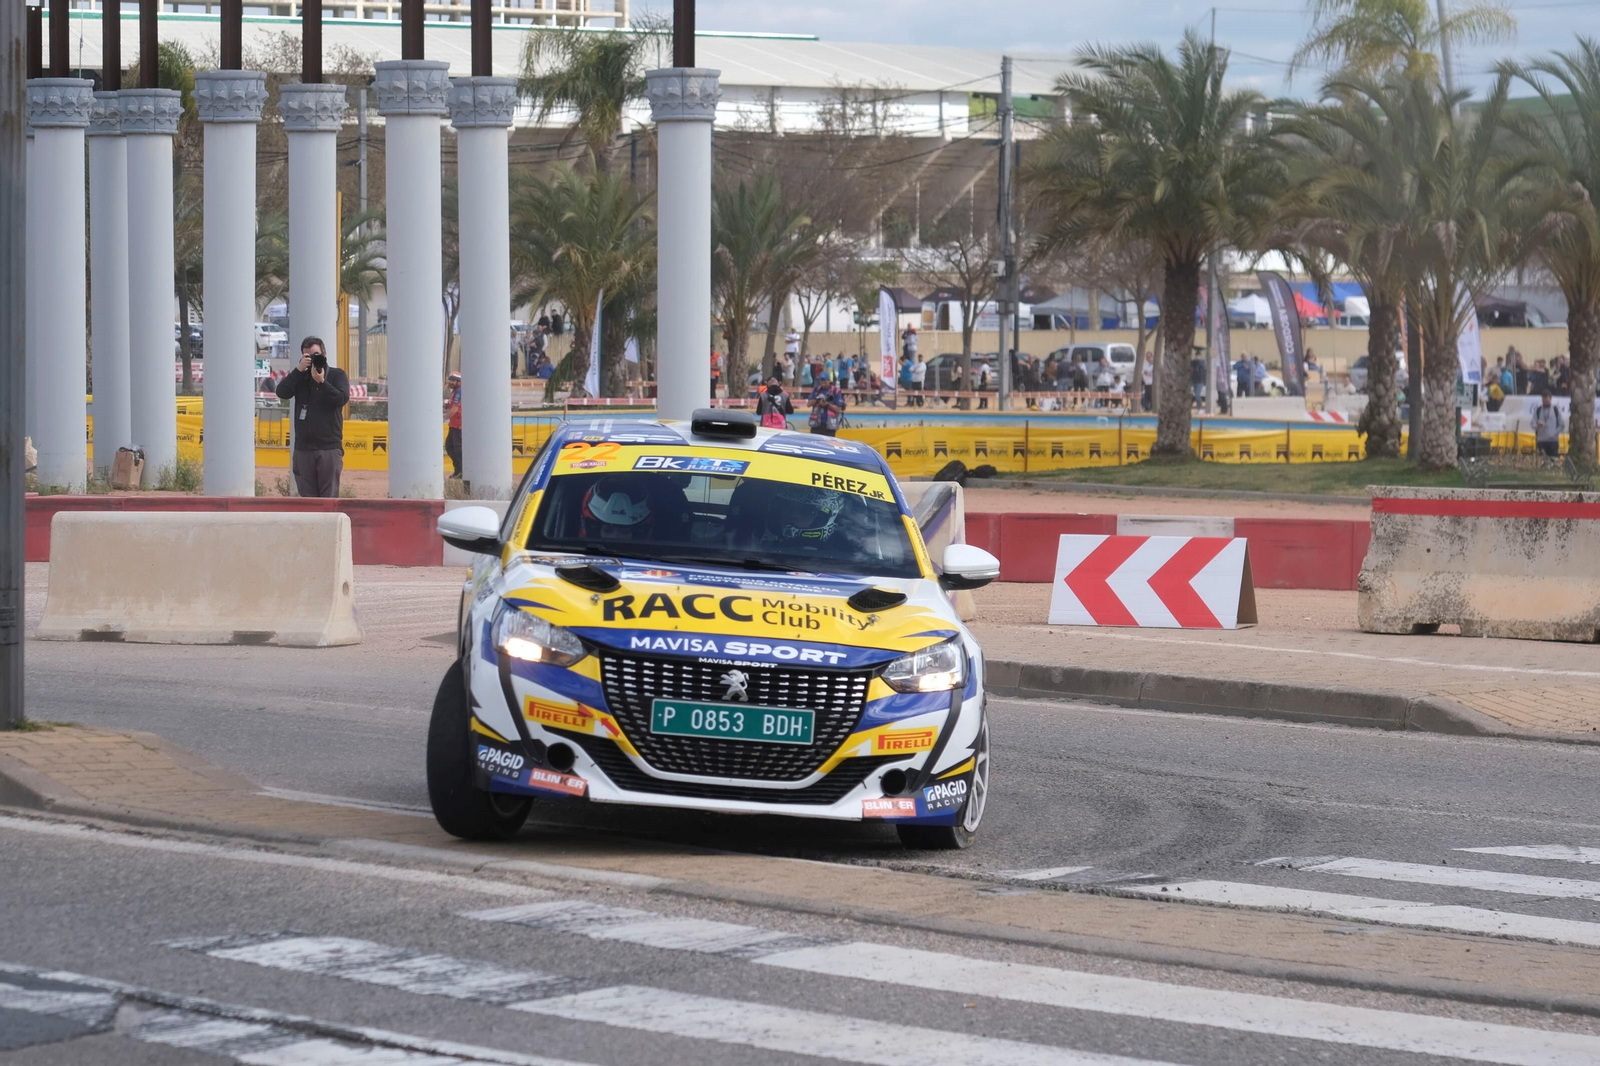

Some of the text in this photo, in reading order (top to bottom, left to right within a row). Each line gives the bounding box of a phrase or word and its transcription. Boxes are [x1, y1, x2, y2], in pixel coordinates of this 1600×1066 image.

[559, 441, 622, 461] 22
[811, 471, 868, 495] PÉREZ
[869, 490, 885, 500] JR
[603, 592, 754, 622] RACC
[762, 597, 871, 631] Mobility
[762, 610, 821, 630] Club
[631, 636, 848, 664] MAVISA SPORT
[528, 701, 589, 727] PIRELLI
[663, 706, 803, 737] P 0853 BDH
[878, 731, 933, 750] PIRELLI
[486, 747, 525, 770] PAGID
[532, 770, 585, 789] BLINKER
[934, 779, 967, 800] PAGID
[863, 799, 914, 811] BLINKER
[927, 795, 967, 811] RACIN
